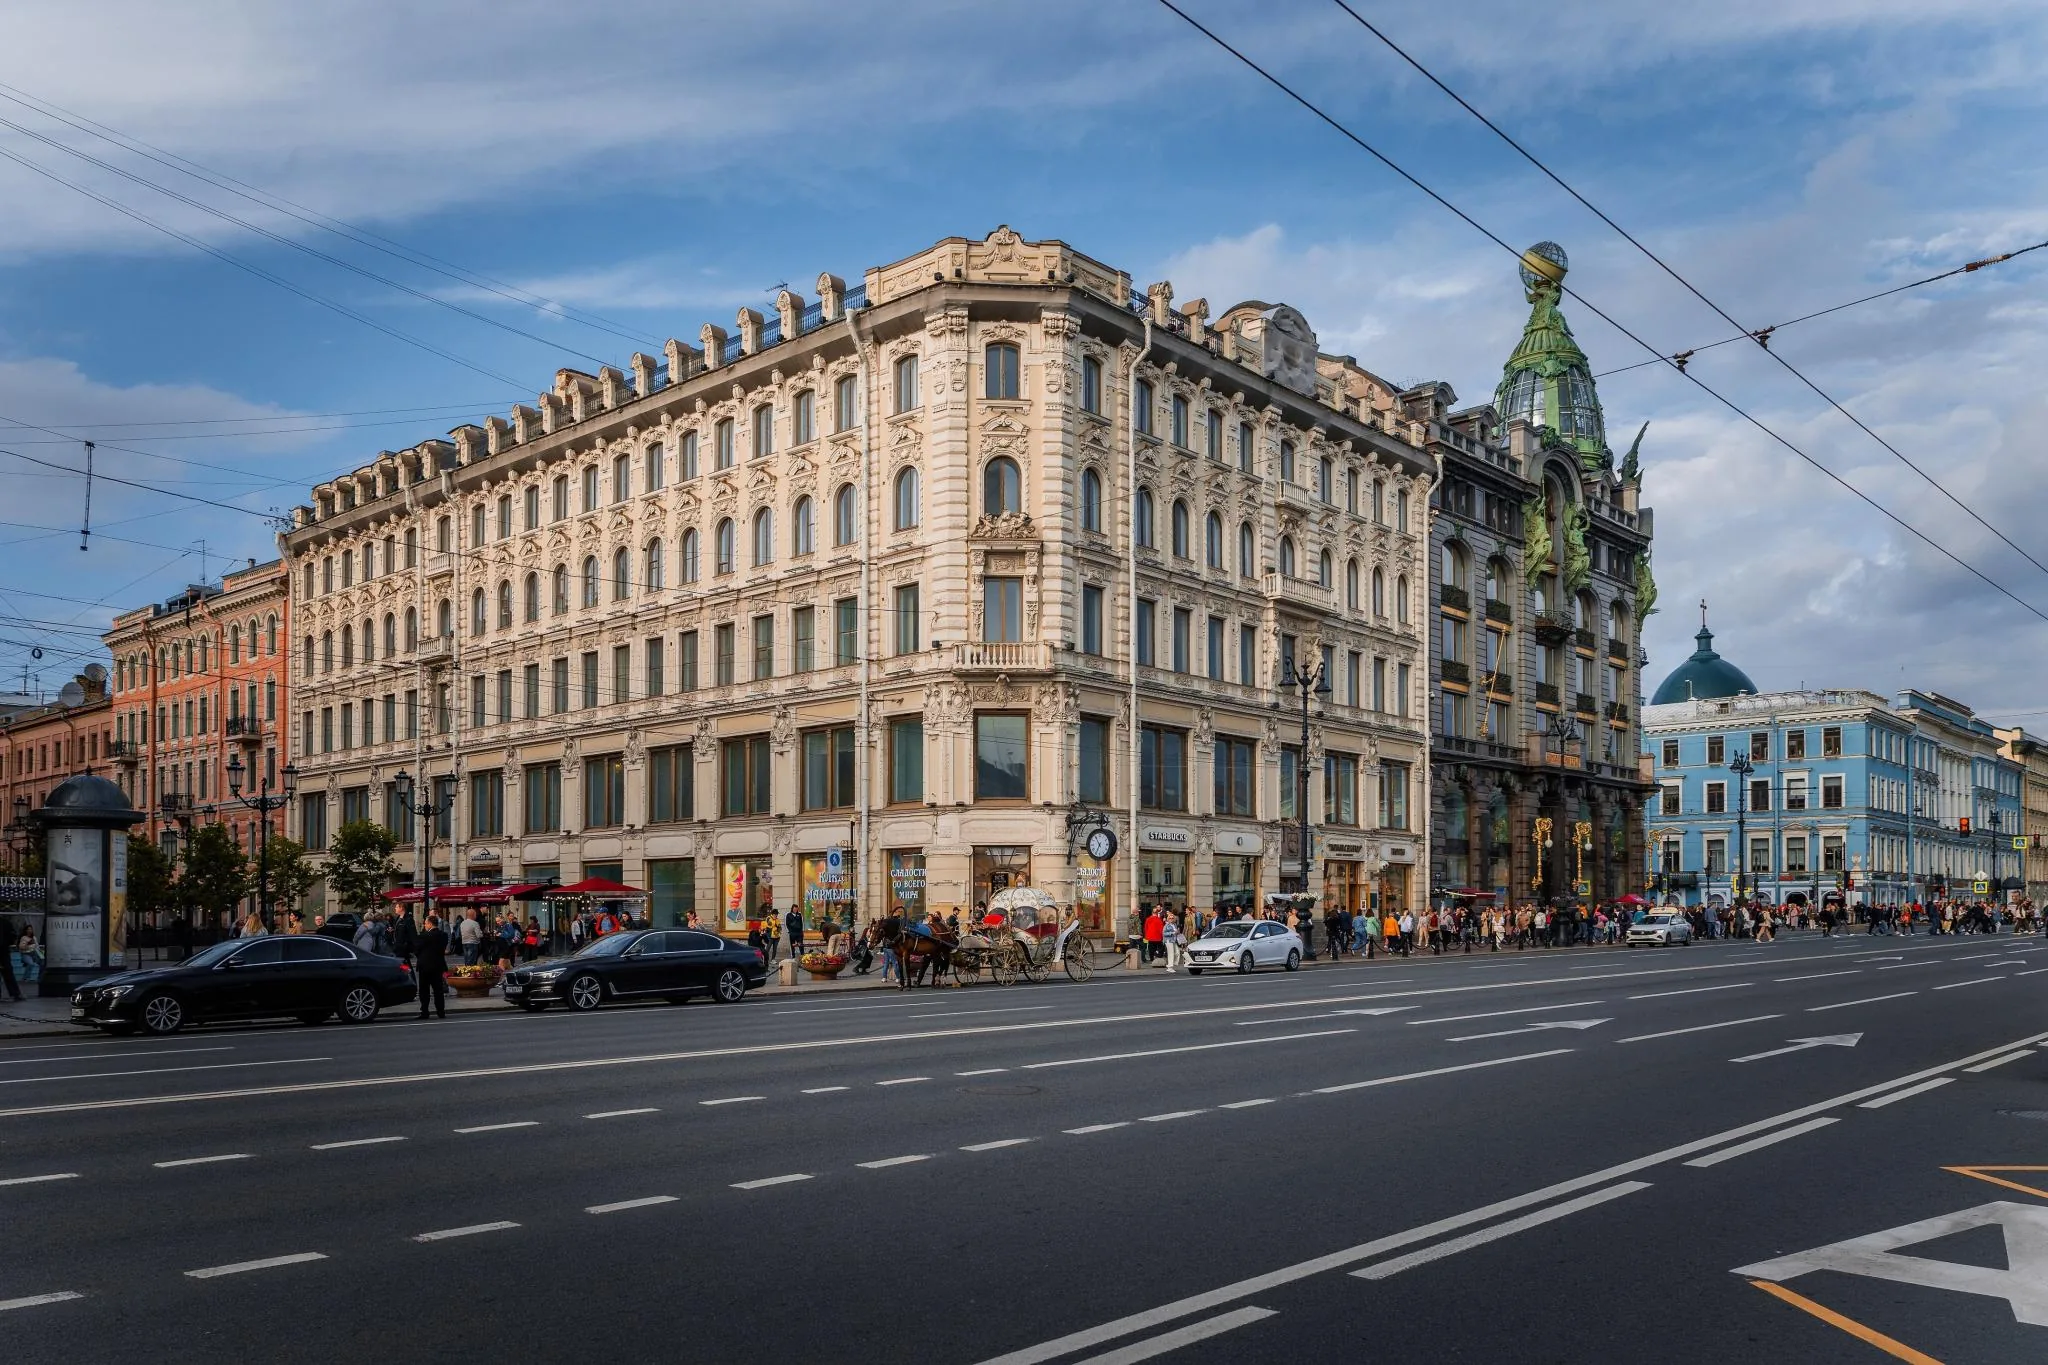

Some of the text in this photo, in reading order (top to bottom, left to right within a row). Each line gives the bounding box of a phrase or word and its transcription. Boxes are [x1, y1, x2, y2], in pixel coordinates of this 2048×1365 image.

[1149, 832, 1188, 842] STARBUCKS
[891, 868, 927, 878] СЛАДОСТИ
[892, 880, 926, 889] СО ВСЕГО
[899, 890, 919, 899] МИРА
